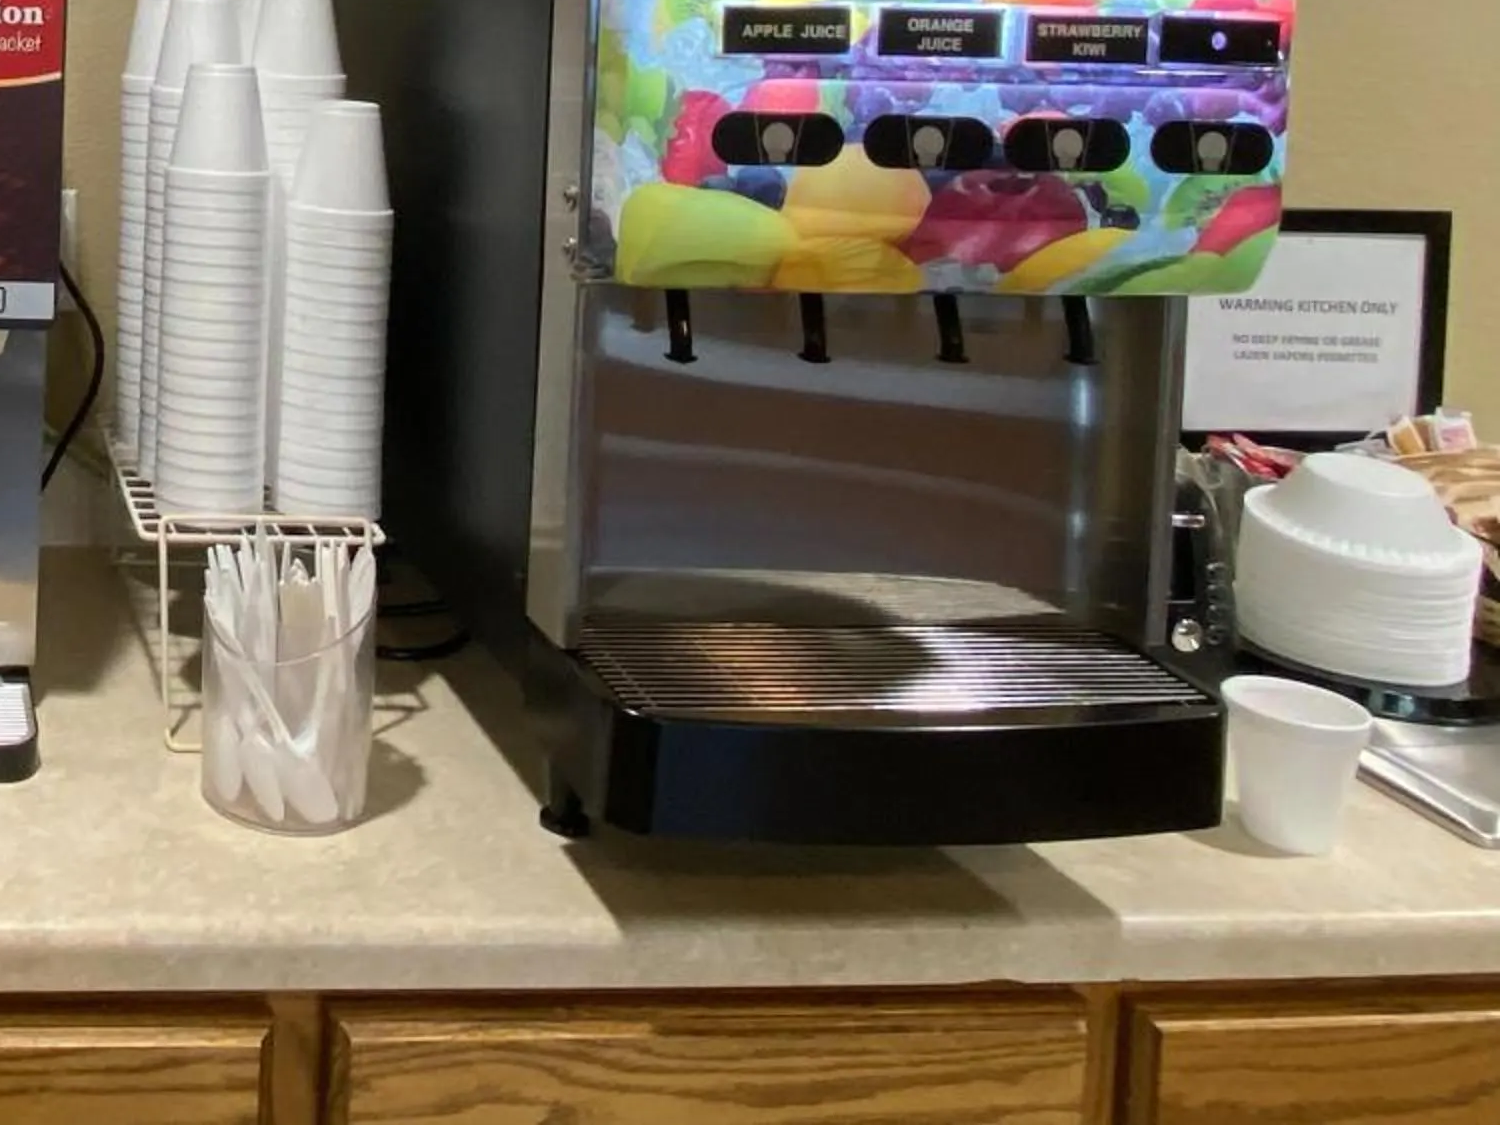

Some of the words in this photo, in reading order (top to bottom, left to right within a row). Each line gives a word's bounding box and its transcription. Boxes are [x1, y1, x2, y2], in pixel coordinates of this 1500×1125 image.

[742, 24, 792, 38] APPLE
[800, 24, 846, 38] JUICE
[907, 18, 975, 33] ORANGE
[1037, 23, 1143, 39] STRAWBERRY
[916, 37, 962, 51] JUICE
[1072, 43, 1107, 56] KIWI
[1219, 298, 1294, 312] WARMING
[1297, 300, 1358, 314] KITCHEN
[1360, 301, 1399, 314] ONLY
